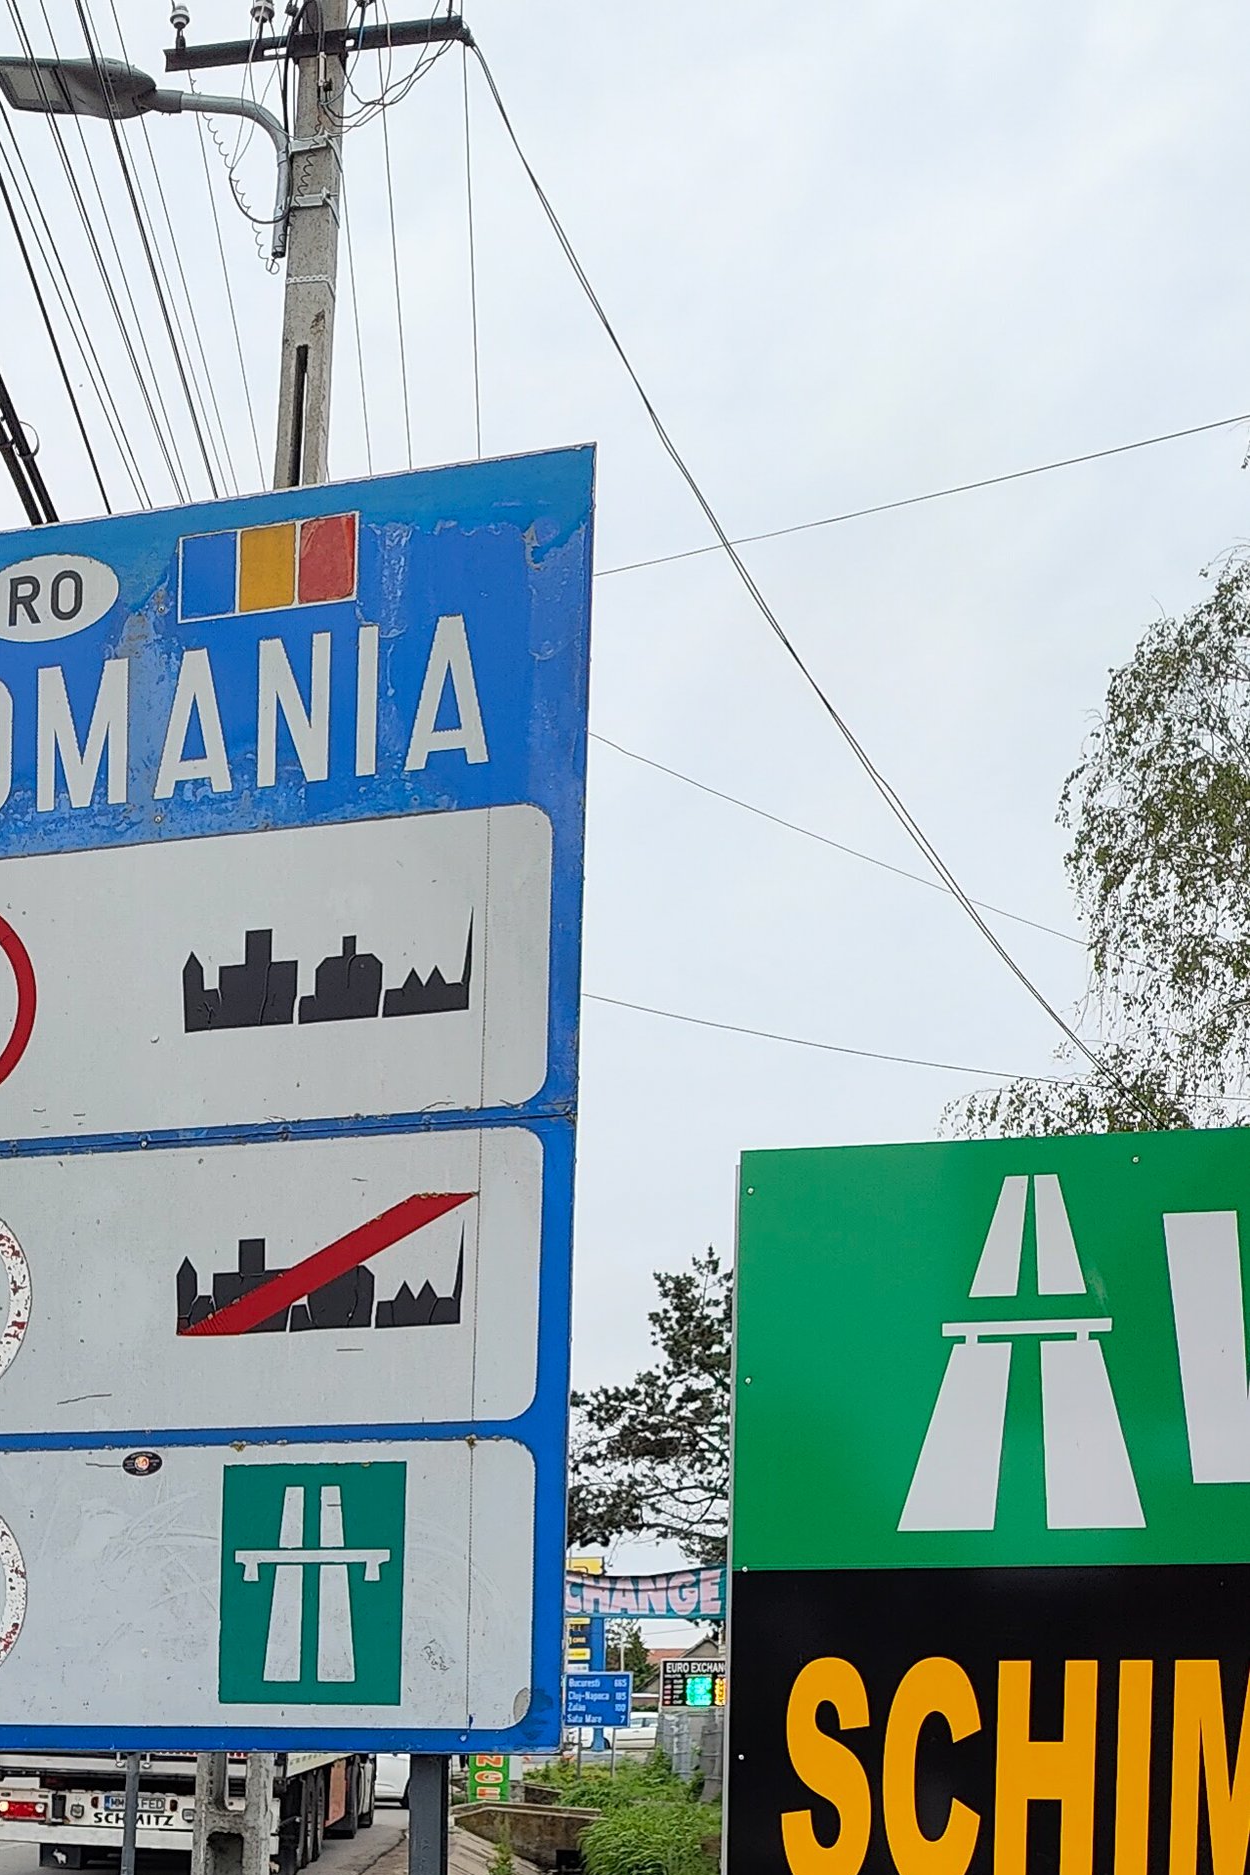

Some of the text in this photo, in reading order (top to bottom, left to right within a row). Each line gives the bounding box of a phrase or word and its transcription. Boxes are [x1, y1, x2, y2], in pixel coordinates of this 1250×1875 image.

[8, 569, 83, 627] RO
[665, 1661, 726, 1674] EURO EXCHAN
